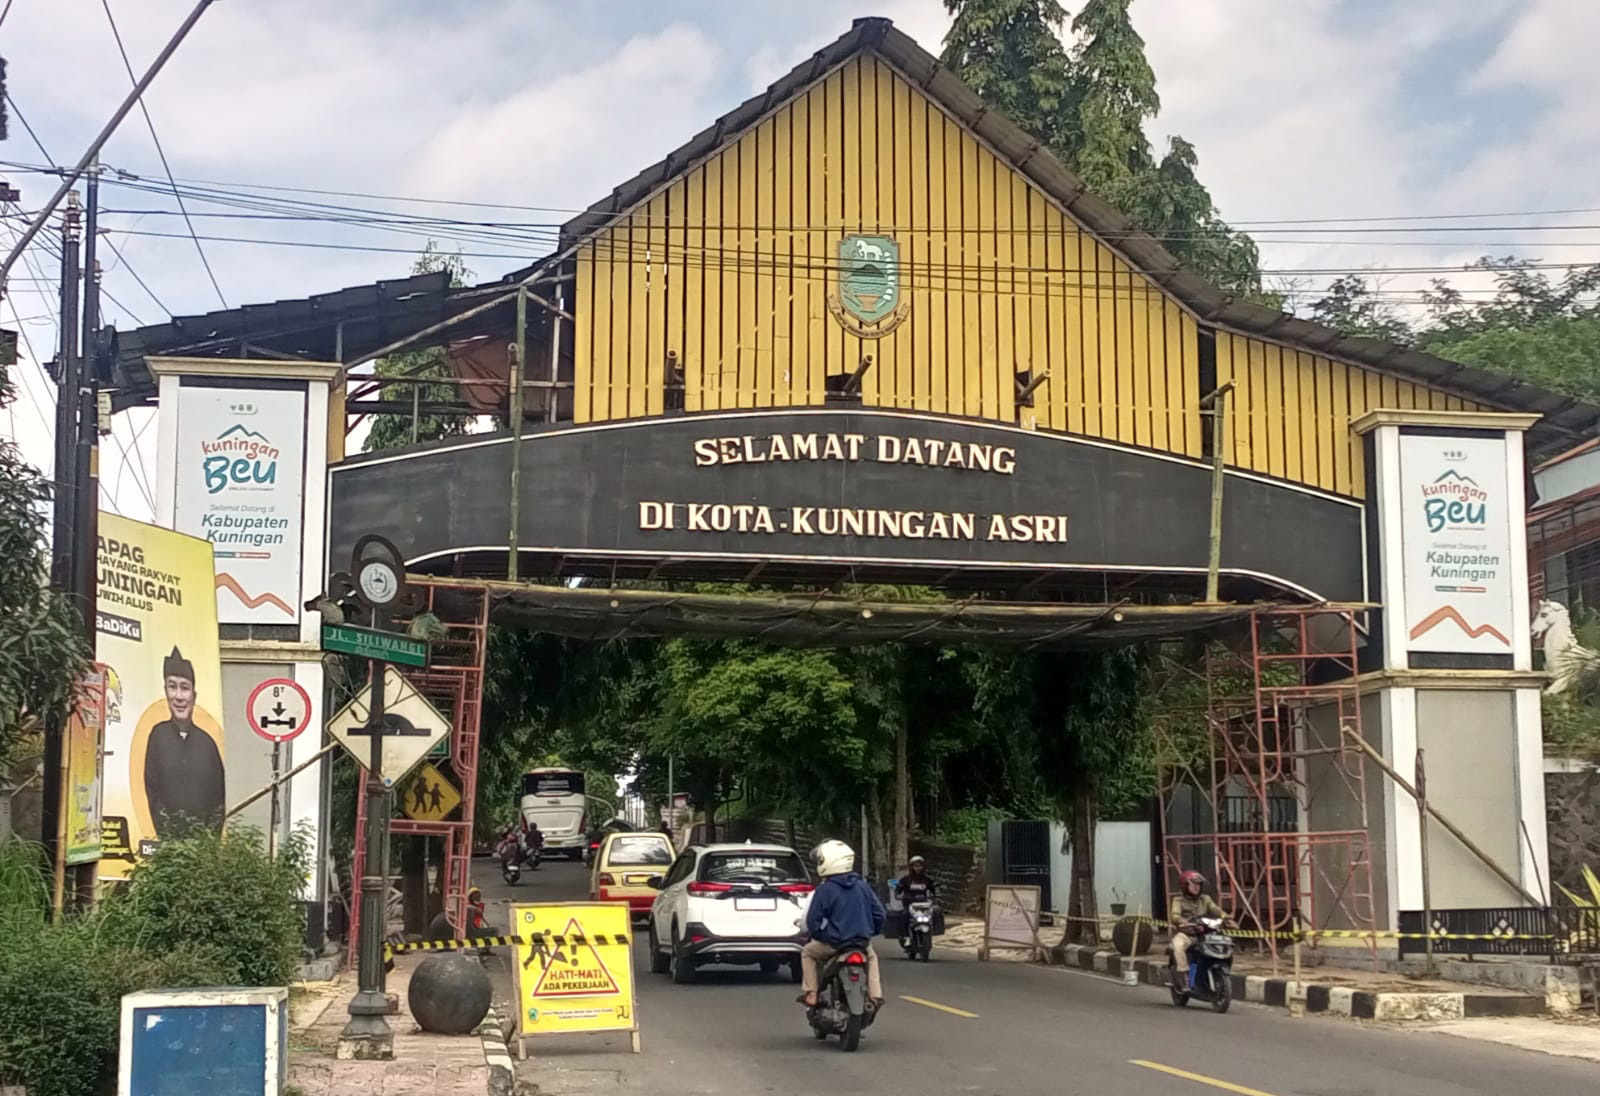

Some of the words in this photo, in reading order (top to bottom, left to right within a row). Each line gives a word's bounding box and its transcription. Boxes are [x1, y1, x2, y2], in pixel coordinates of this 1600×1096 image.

[201, 437, 280, 460] kuningan
[693, 432, 865, 466] SELAMAT
[877, 435, 1016, 474] DATANG
[203, 455, 276, 494] Beu
[1421, 481, 1488, 502] kuningan
[201, 513, 289, 532] Kabupaten
[639, 501, 675, 529] DI
[986, 513, 1068, 542] ASRI
[1424, 498, 1486, 533] Beu
[206, 529, 284, 547] Kuningan
[1426, 551, 1500, 569] Kabupaten
[139, 566, 182, 587] RAKYAT
[1430, 566, 1496, 582] Kuningan
[125, 596, 154, 612] ALUS
[356, 632, 425, 655] SILIWANGI
[543, 981, 560, 991] ADA
[562, 980, 609, 990] PEKERJAAN
[550, 969, 603, 981] HATI-HATI
